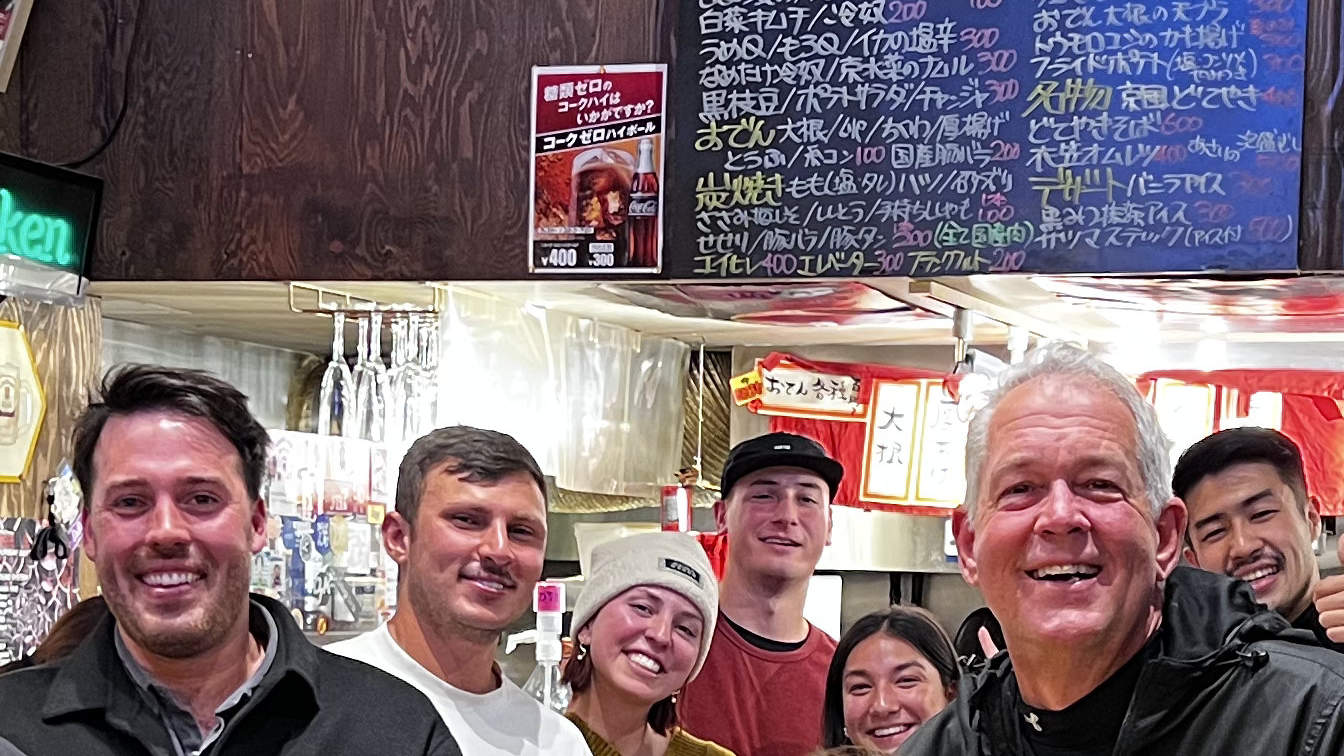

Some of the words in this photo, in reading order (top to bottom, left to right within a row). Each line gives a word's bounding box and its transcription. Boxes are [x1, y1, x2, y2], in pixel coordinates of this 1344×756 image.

[960, 28, 999, 50] 300
[977, 50, 1018, 75] 300
[558, 92, 621, 113] コークハイは
[985, 79, 1019, 104] 300
[695, 116, 776, 149] おでん
[1160, 112, 1204, 135] 600
[856, 146, 886, 166] 100
[695, 171, 784, 212] 炭焼き
[761, 253, 798, 274] 400
